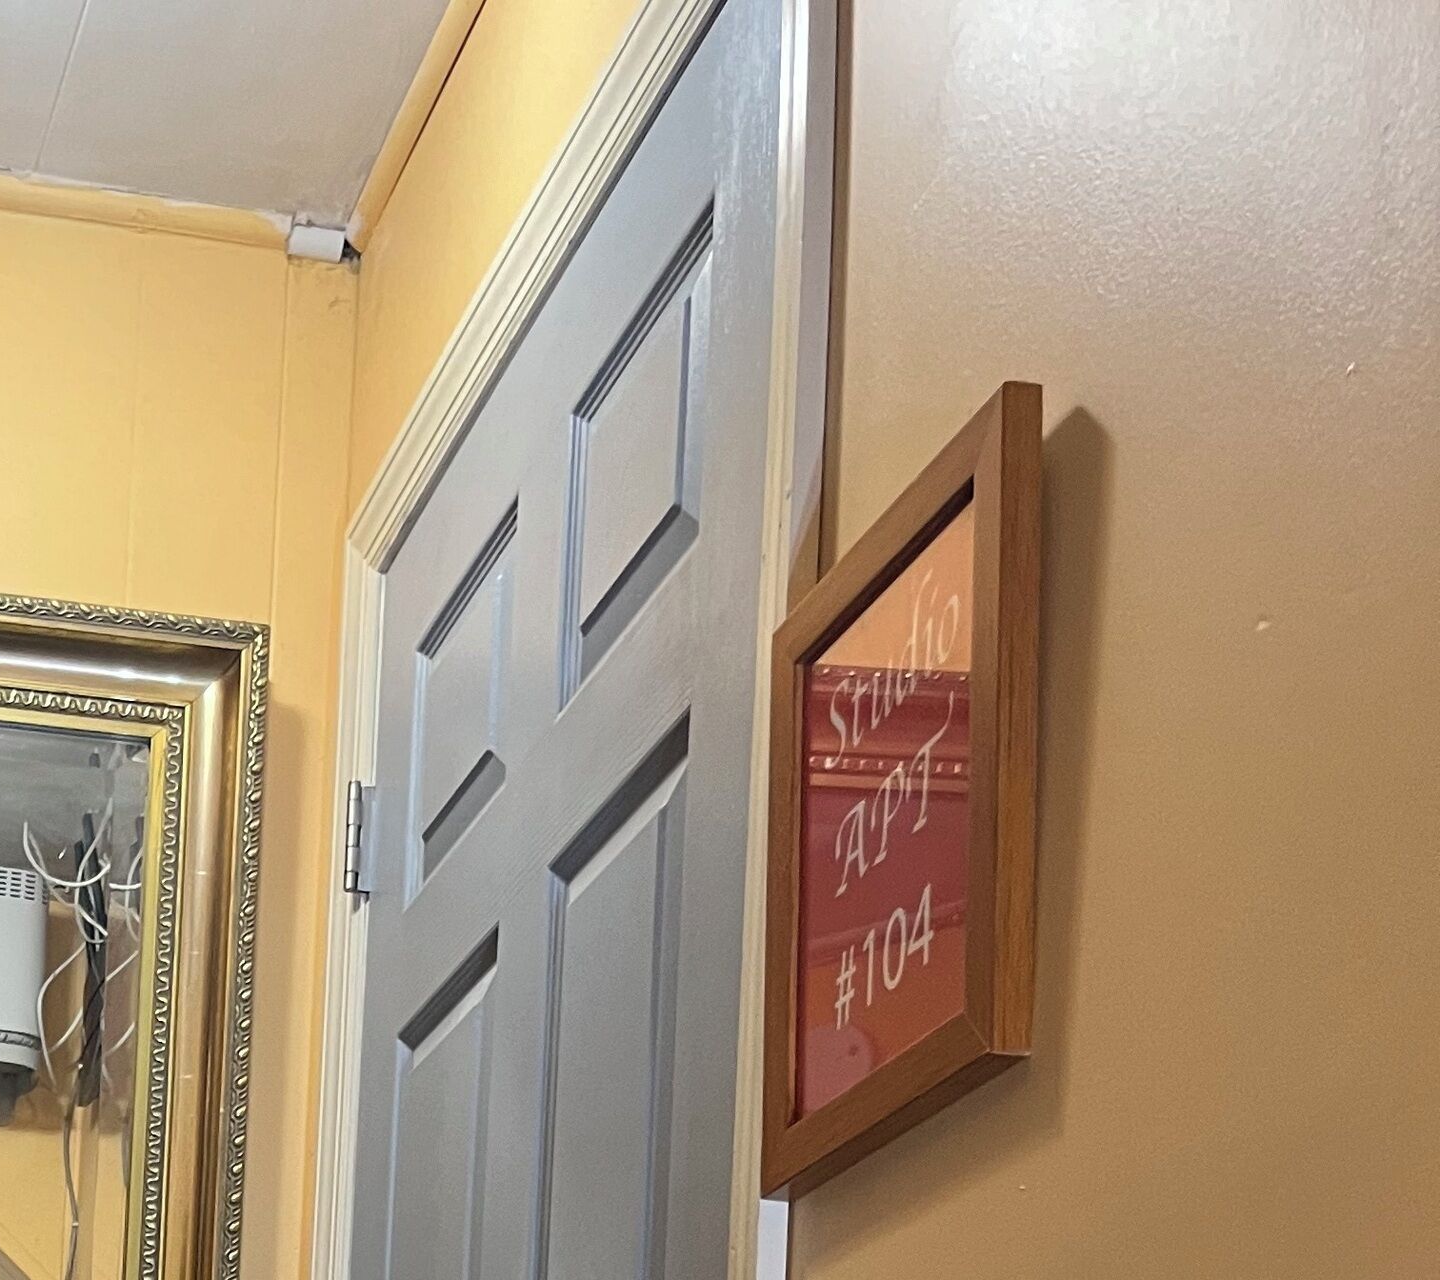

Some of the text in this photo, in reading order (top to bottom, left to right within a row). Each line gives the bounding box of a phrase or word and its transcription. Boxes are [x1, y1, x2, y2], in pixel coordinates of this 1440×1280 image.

[829, 567, 961, 770] Studio
[834, 690, 954, 898] APT
[834, 882, 935, 1031] #104
